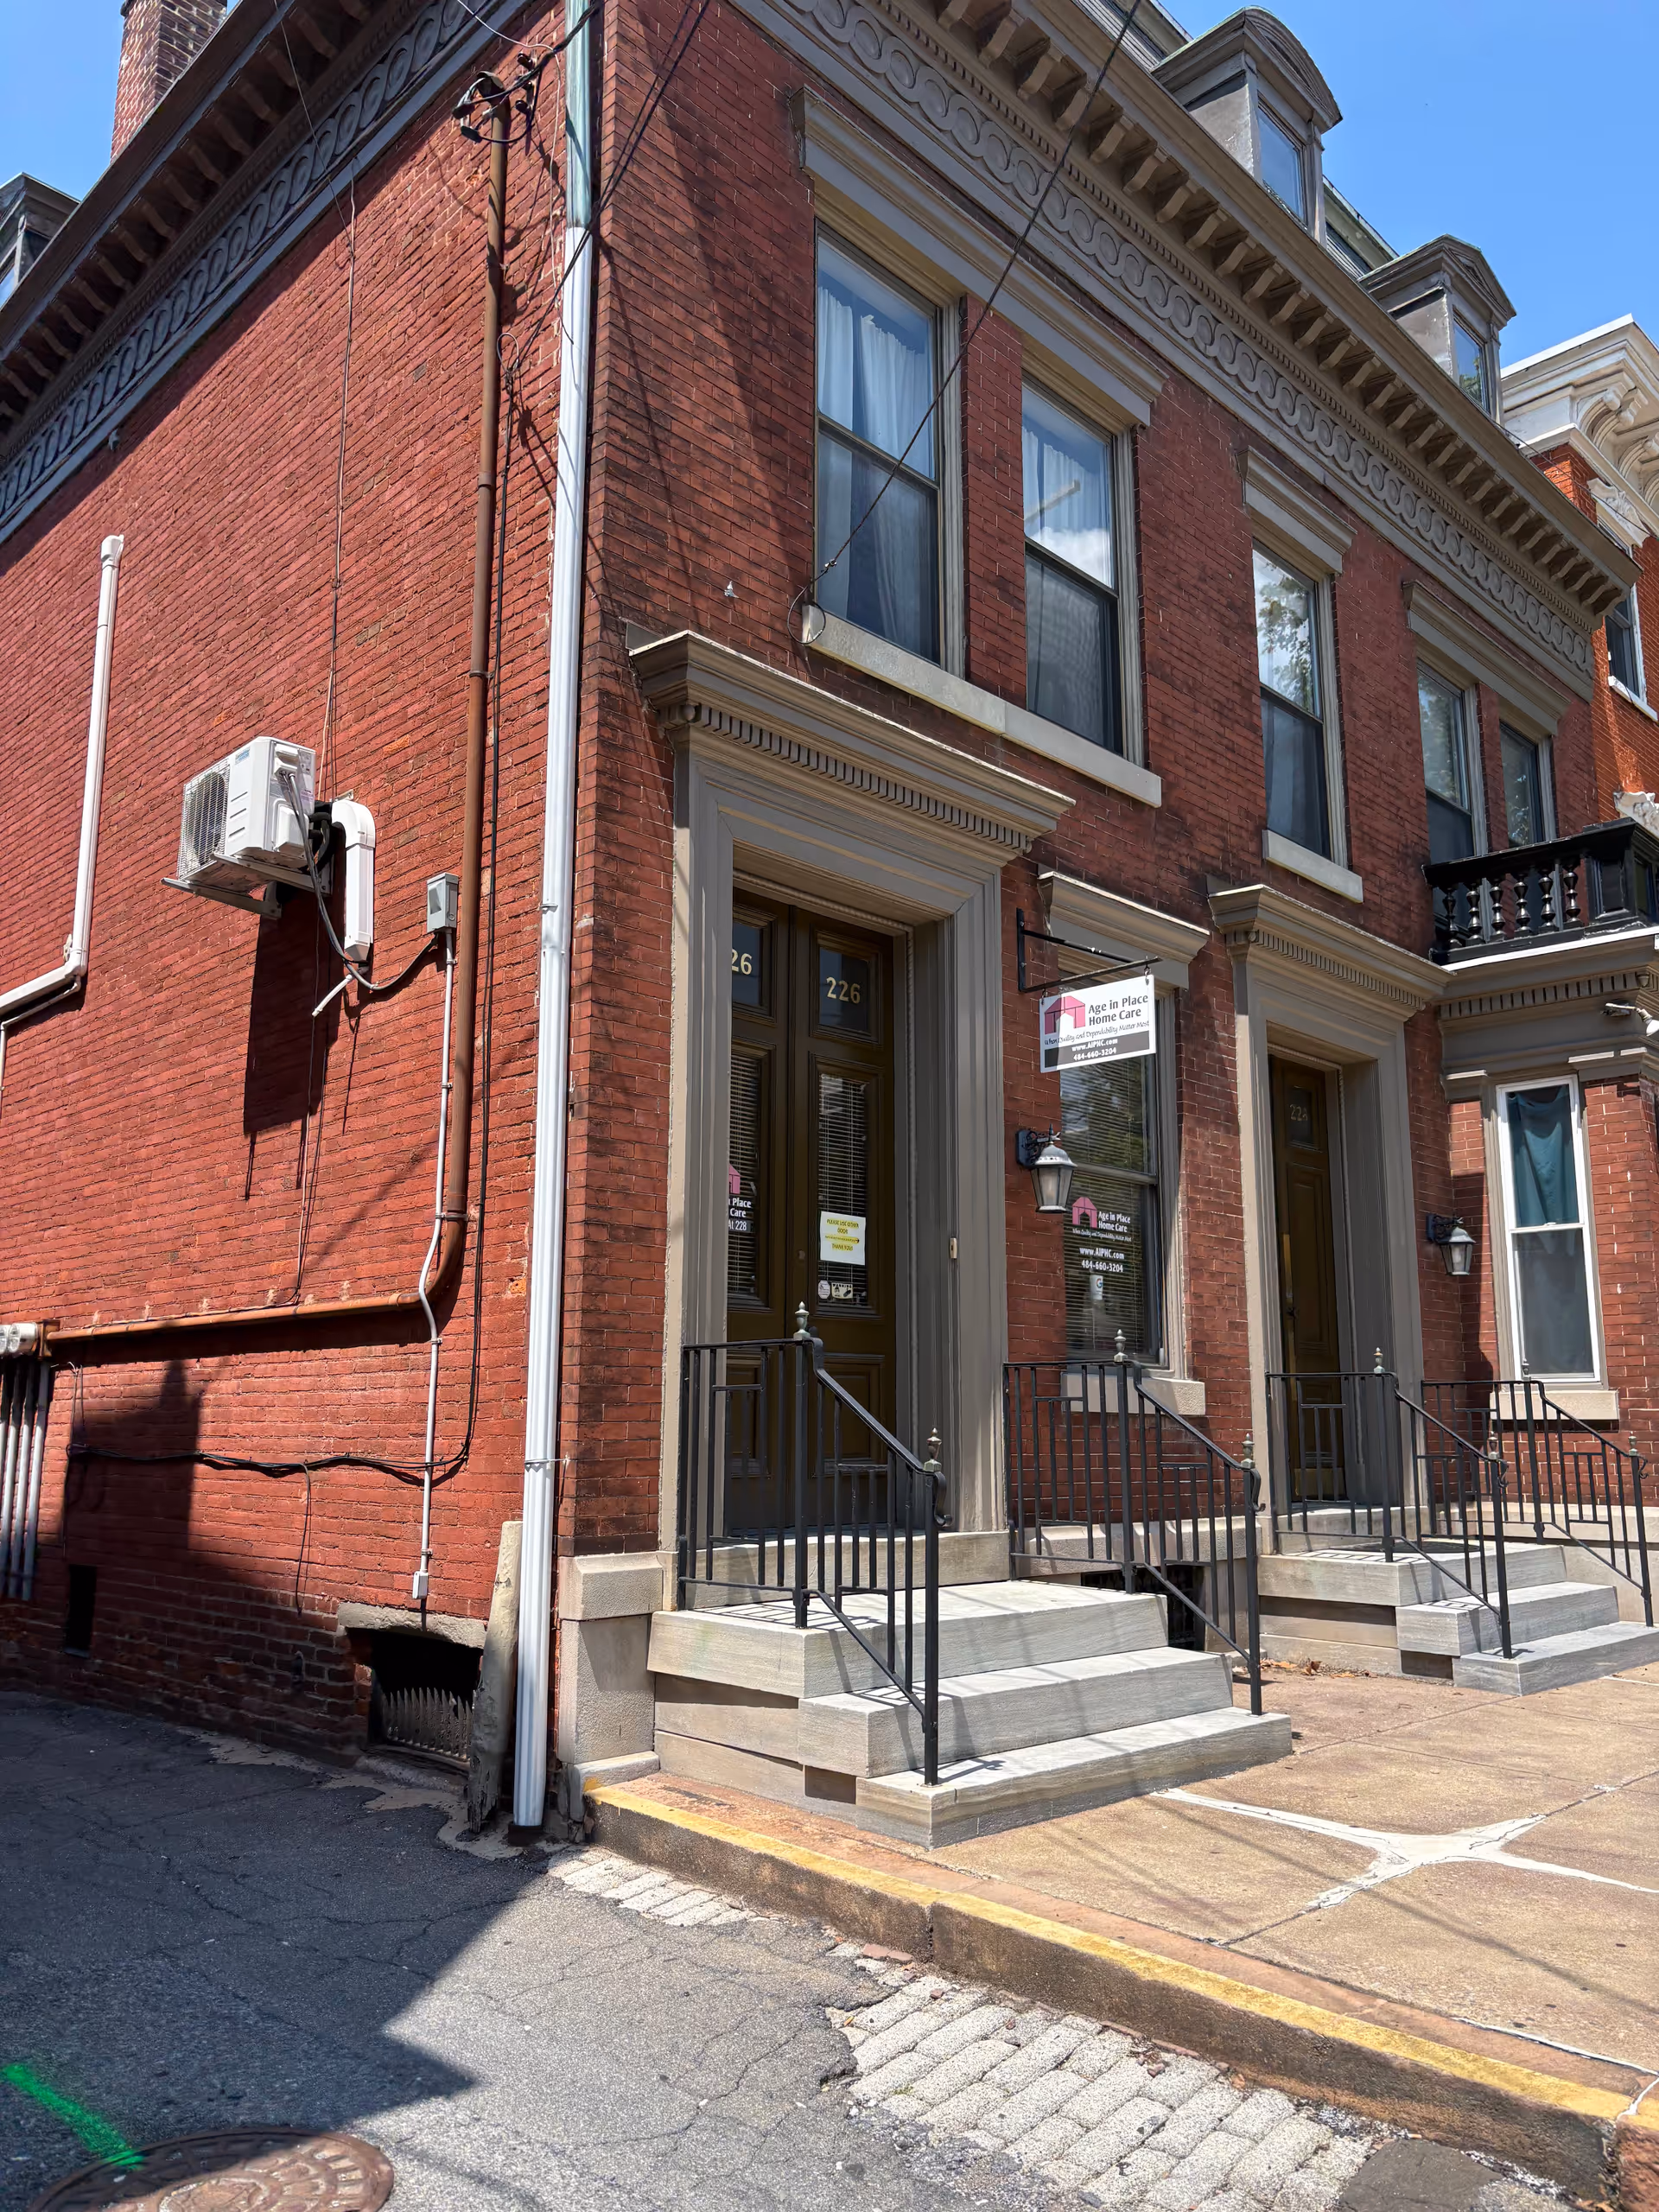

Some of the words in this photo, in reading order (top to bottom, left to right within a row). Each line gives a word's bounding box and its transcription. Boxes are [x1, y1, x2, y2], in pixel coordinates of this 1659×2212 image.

[826, 976, 861, 1004] 226
[1089, 1003, 1107, 1015] Age
[1109, 1000, 1118, 1009] in
[1122, 995, 1148, 1007] Place
[1089, 1014, 1117, 1027] Home
[1119, 1008, 1141, 1020] Care
[1044, 1037, 1058, 1046] When
[1058, 1033, 1075, 1043] Quality
[1076, 1030, 1086, 1039] and
[1086, 1026, 1119, 1039] Dependability
[1071, 1038, 1118, 1052] www.AIPHC.com
[1073, 1046, 1117, 1061] 484-660-3204
[732, 1197, 752, 1208] Place
[730, 1208, 747, 1217] Care
[1098, 1211, 1109, 1222] Age
[1109, 1211, 1116, 1221] in
[1116, 1213, 1130, 1224] Place
[735, 1220, 747, 1231] 228
[1098, 1220, 1115, 1230] Home
[1116, 1223, 1128, 1233] Care
[1079, 1247, 1124, 1260] www.AIPHC.com
[1082, 1259, 1123, 1273] 484-660-3204
[1096, 1278, 1103, 1288] G
